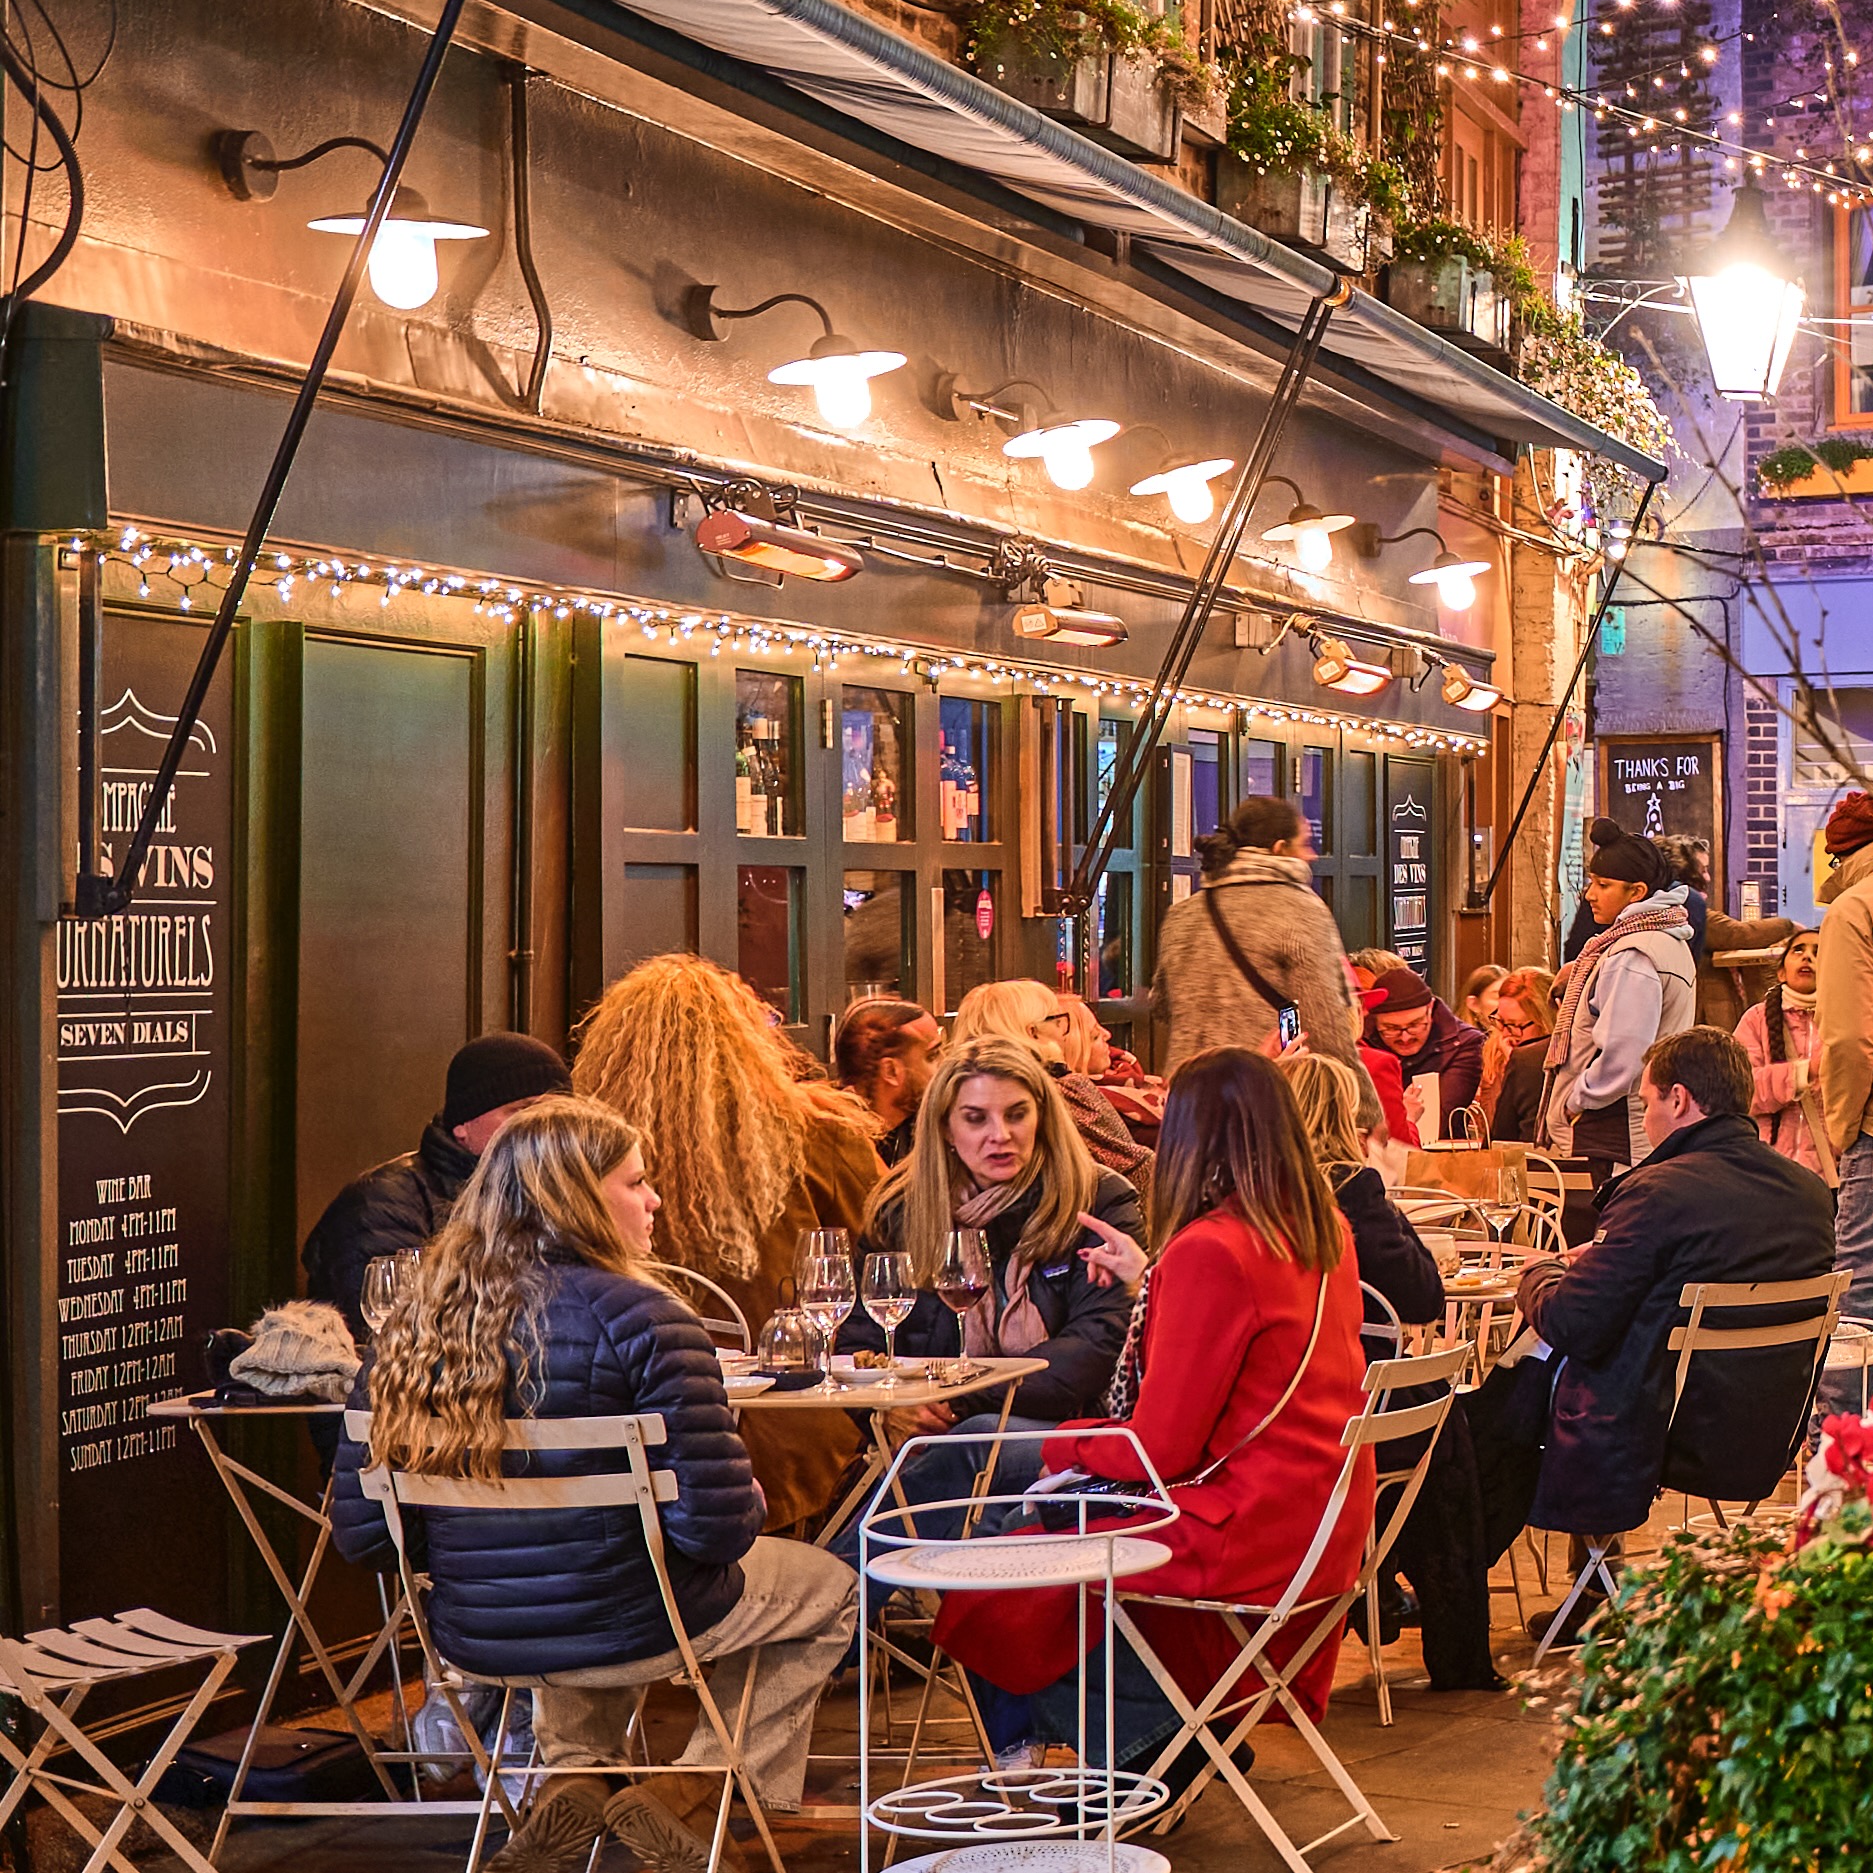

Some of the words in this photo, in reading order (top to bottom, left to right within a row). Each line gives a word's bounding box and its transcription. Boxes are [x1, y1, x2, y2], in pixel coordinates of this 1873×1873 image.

[1614, 757, 1669, 780] THANKS
[1676, 755, 1700, 776] FOR
[1624, 782, 1651, 794] BEING
[1656, 780, 1664, 791] A
[1667, 779, 1685, 791] BIG
[131, 844, 214, 890] VINS
[56, 914, 214, 989] URNATURELS
[60, 1022, 126, 1047] SEVEN
[132, 1020, 189, 1045] DIALS
[96, 1177, 126, 1205] WINE
[128, 1174, 152, 1200] BAR
[69, 1215, 116, 1247] MONDAY
[121, 1207, 177, 1238] 4PM-11PM
[67, 1252, 115, 1284] TUESDAY
[124, 1243, 179, 1275] 4PM-11PM
[58, 1288, 125, 1323] WEDNESDAY
[133, 1278, 188, 1310] 4PM-11PM
[62, 1326, 118, 1360] THURSDAY
[122, 1315, 184, 1349] 12PM-12AM
[70, 1364, 110, 1397] FRIDAY
[114, 1352, 176, 1388] 12PM-12AM
[61, 1400, 118, 1436] SATURDAY
[70, 1438, 113, 1472] SUNDAY
[116, 1425, 177, 1461] 12PM-11PM
